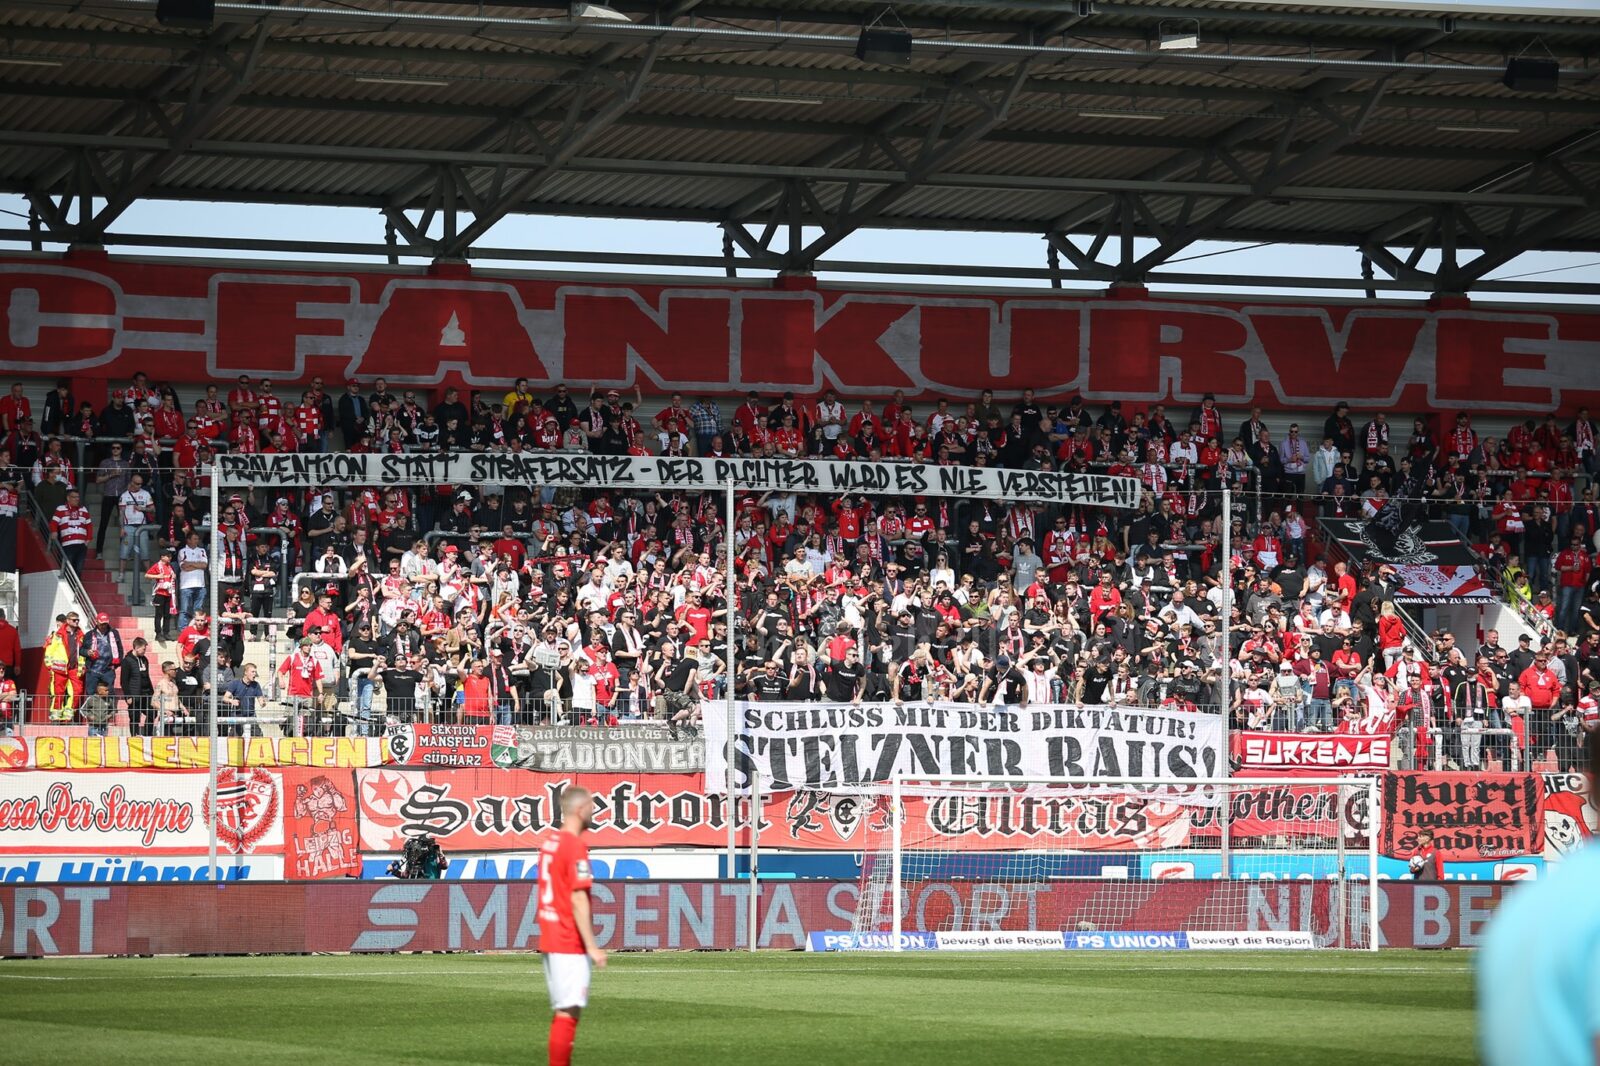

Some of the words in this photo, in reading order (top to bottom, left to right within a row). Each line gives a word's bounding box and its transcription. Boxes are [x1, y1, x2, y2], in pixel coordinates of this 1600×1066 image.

[219, 454, 367, 485] PRÄVENTION
[381, 454, 459, 483] STATT
[471, 453, 634, 485] STRAFERSATZ
[656, 458, 703, 485] DER
[715, 460, 818, 489] RICHTER
[829, 463, 890, 490] WIRD
[895, 464, 928, 493] ES
[939, 466, 987, 495] NIE
[997, 470, 1136, 508] VERSTEHEN!
[1450, 597, 1461, 605] ZU
[388, 724, 407, 737] HFC
[431, 725, 476, 735] SEKTION
[744, 707, 884, 731] SCHLUSS
[895, 706, 949, 729] MIT
[959, 710, 1020, 733] DER
[1031, 709, 1196, 740] DIKTATUR!
[35, 735, 210, 768] BULLEN
[419, 736, 488, 747] MANSFELD
[1246, 739, 1388, 765] SURREALE
[423, 750, 482, 766] SÜDHARZ
[722, 733, 1029, 793] STELZNER
[1045, 735, 1216, 800] RAUS!
[41, 782, 94, 832] Per
[95, 784, 193, 846] Sempre
[294, 828, 353, 856] LEIPZIG
[1397, 829, 1525, 851] Sadion
[296, 848, 358, 877] HALLE
[0, 887, 110, 953] RT
[824, 935, 849, 948] PS
[940, 936, 989, 948] bewegt
[994, 936, 1013, 946] die
[1017, 936, 1063, 948] Region
[1077, 935, 1105, 948] PS
[1110, 935, 1176, 948] UNION
[1191, 936, 1240, 948] bewegt
[1244, 936, 1262, 946] die
[1266, 936, 1312, 948] Region
